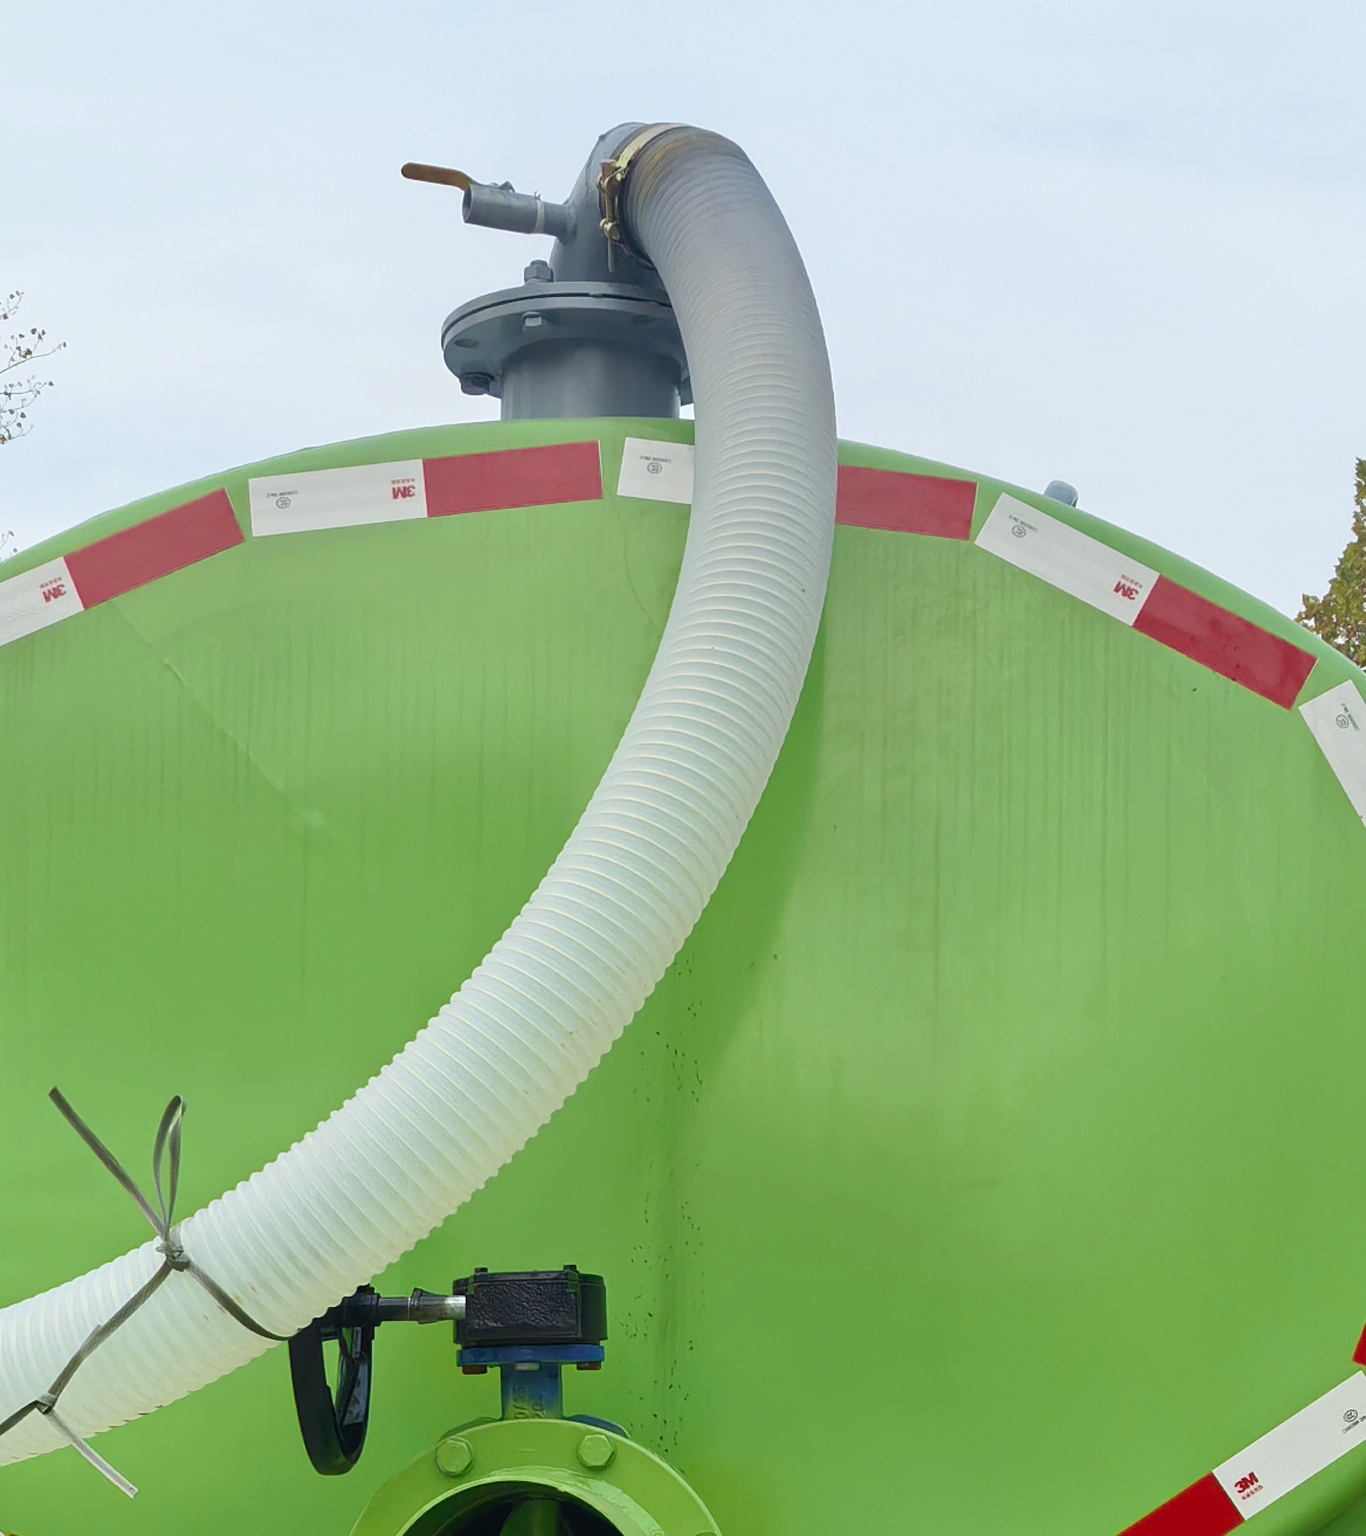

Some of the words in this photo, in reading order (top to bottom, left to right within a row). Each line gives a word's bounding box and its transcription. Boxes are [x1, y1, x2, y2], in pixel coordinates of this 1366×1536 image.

[391, 485, 416, 500] 3M
[42, 584, 67, 603] 3M
[1113, 581, 1139, 601] 3M
[1234, 1472, 1259, 1494] 3M
